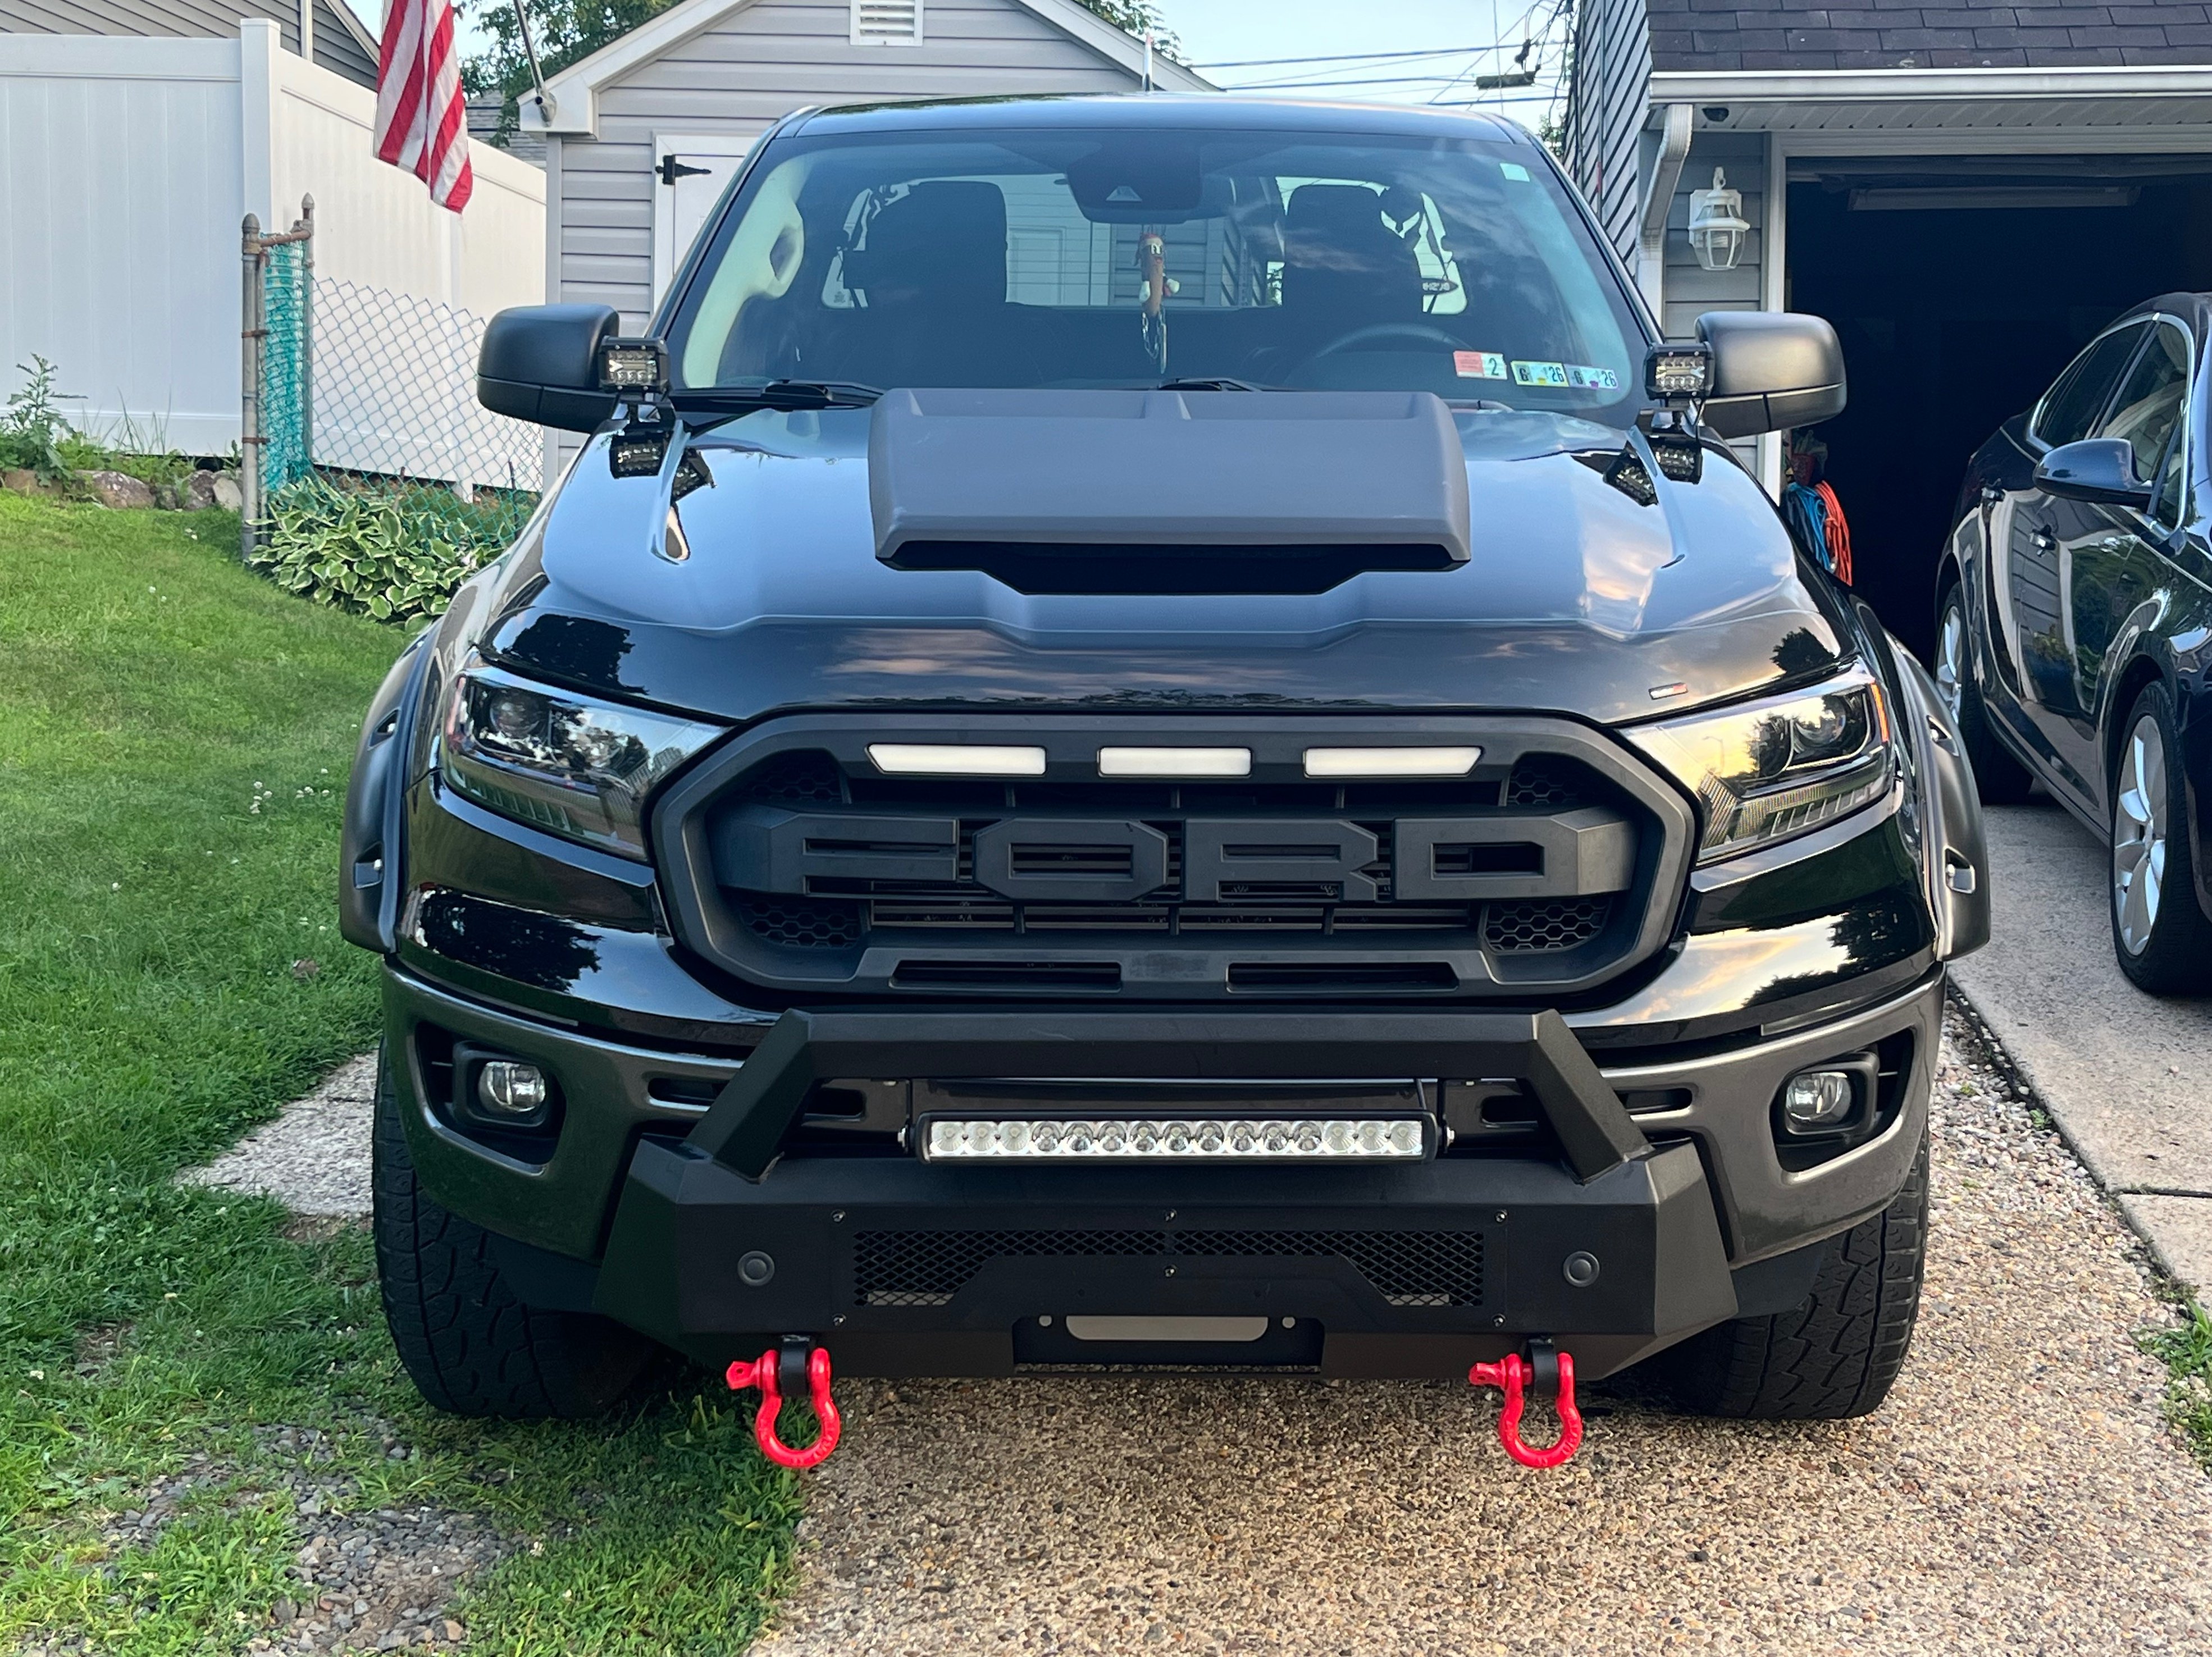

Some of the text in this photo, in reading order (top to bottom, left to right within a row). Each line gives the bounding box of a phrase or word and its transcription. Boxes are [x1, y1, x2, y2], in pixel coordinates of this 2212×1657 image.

[1549, 366, 1565, 382] 26
[1601, 371, 1617, 387] 26
[764, 812, 1580, 902] FORD
